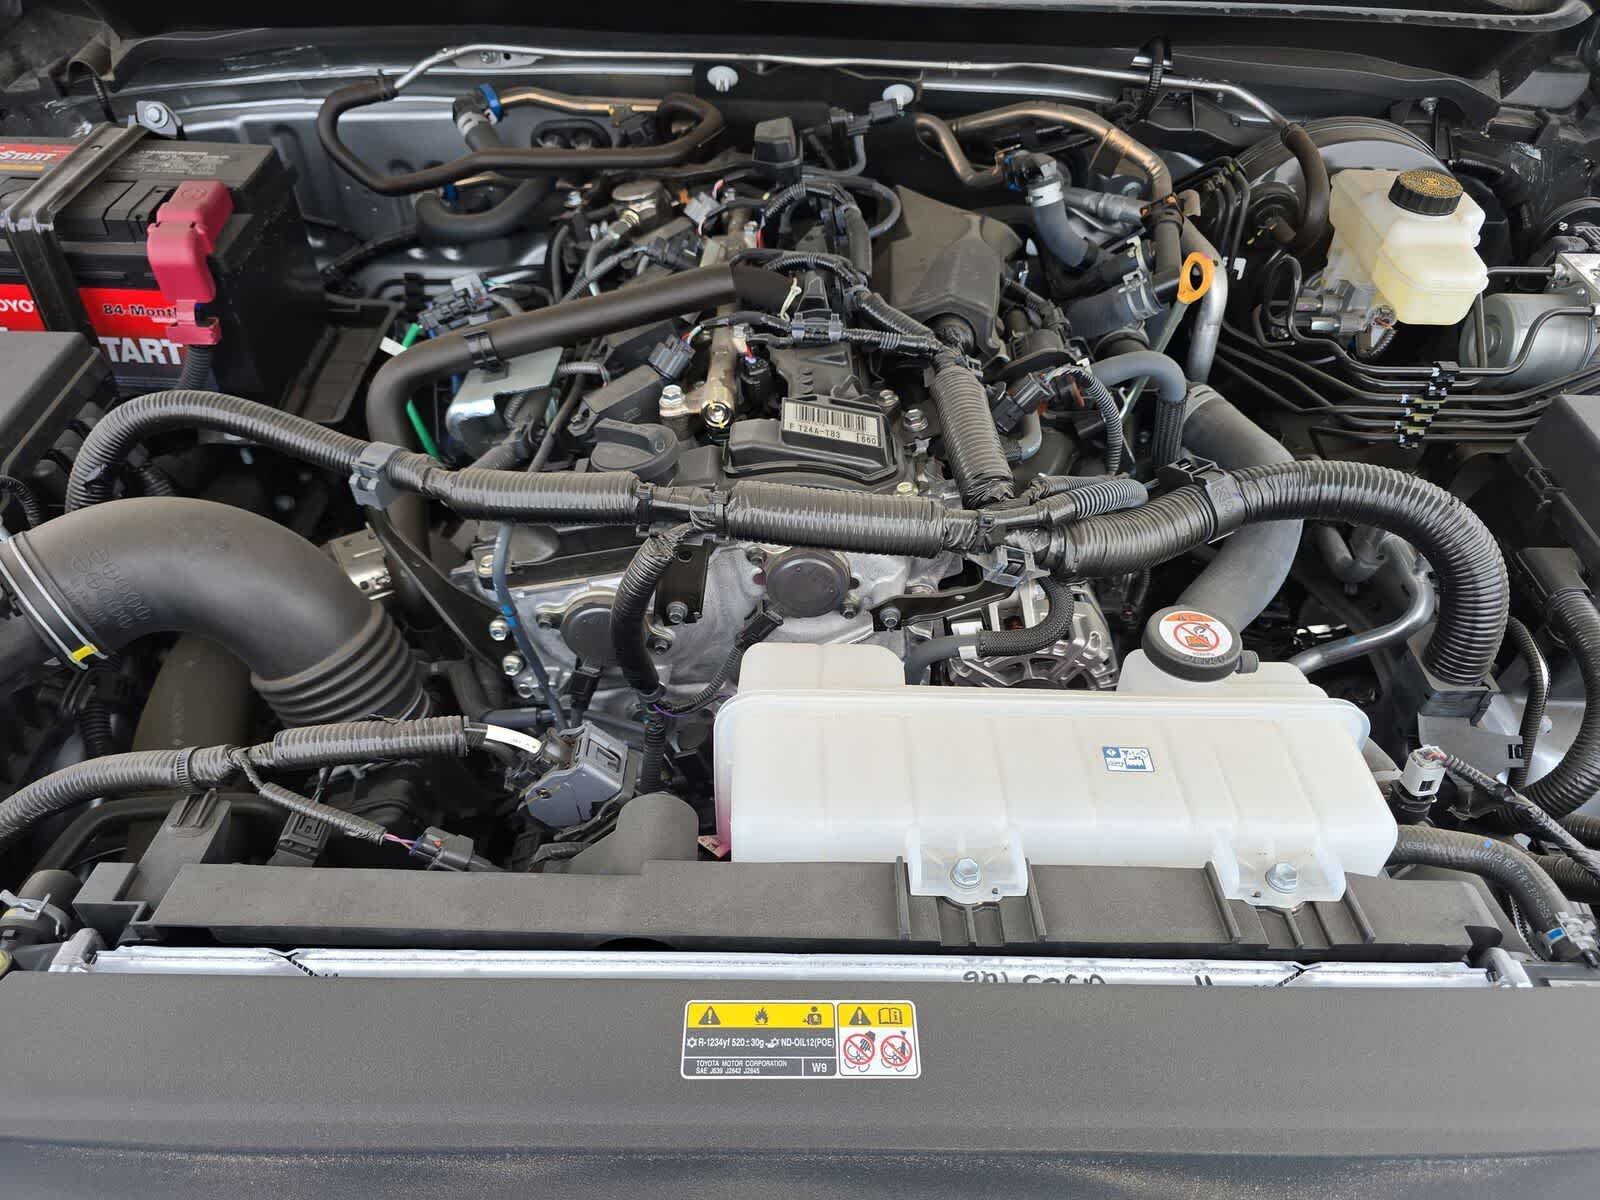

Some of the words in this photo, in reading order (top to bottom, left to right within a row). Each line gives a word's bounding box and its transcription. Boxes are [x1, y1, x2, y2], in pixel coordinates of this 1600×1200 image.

[98, 336, 183, 365] TART
[698, 1037, 730, 1048] R-1234yf
[731, 1037, 764, 1049] 520±30g
[781, 1037, 834, 1049] ND-OIL12(POE)
[811, 1062, 827, 1073] W9
